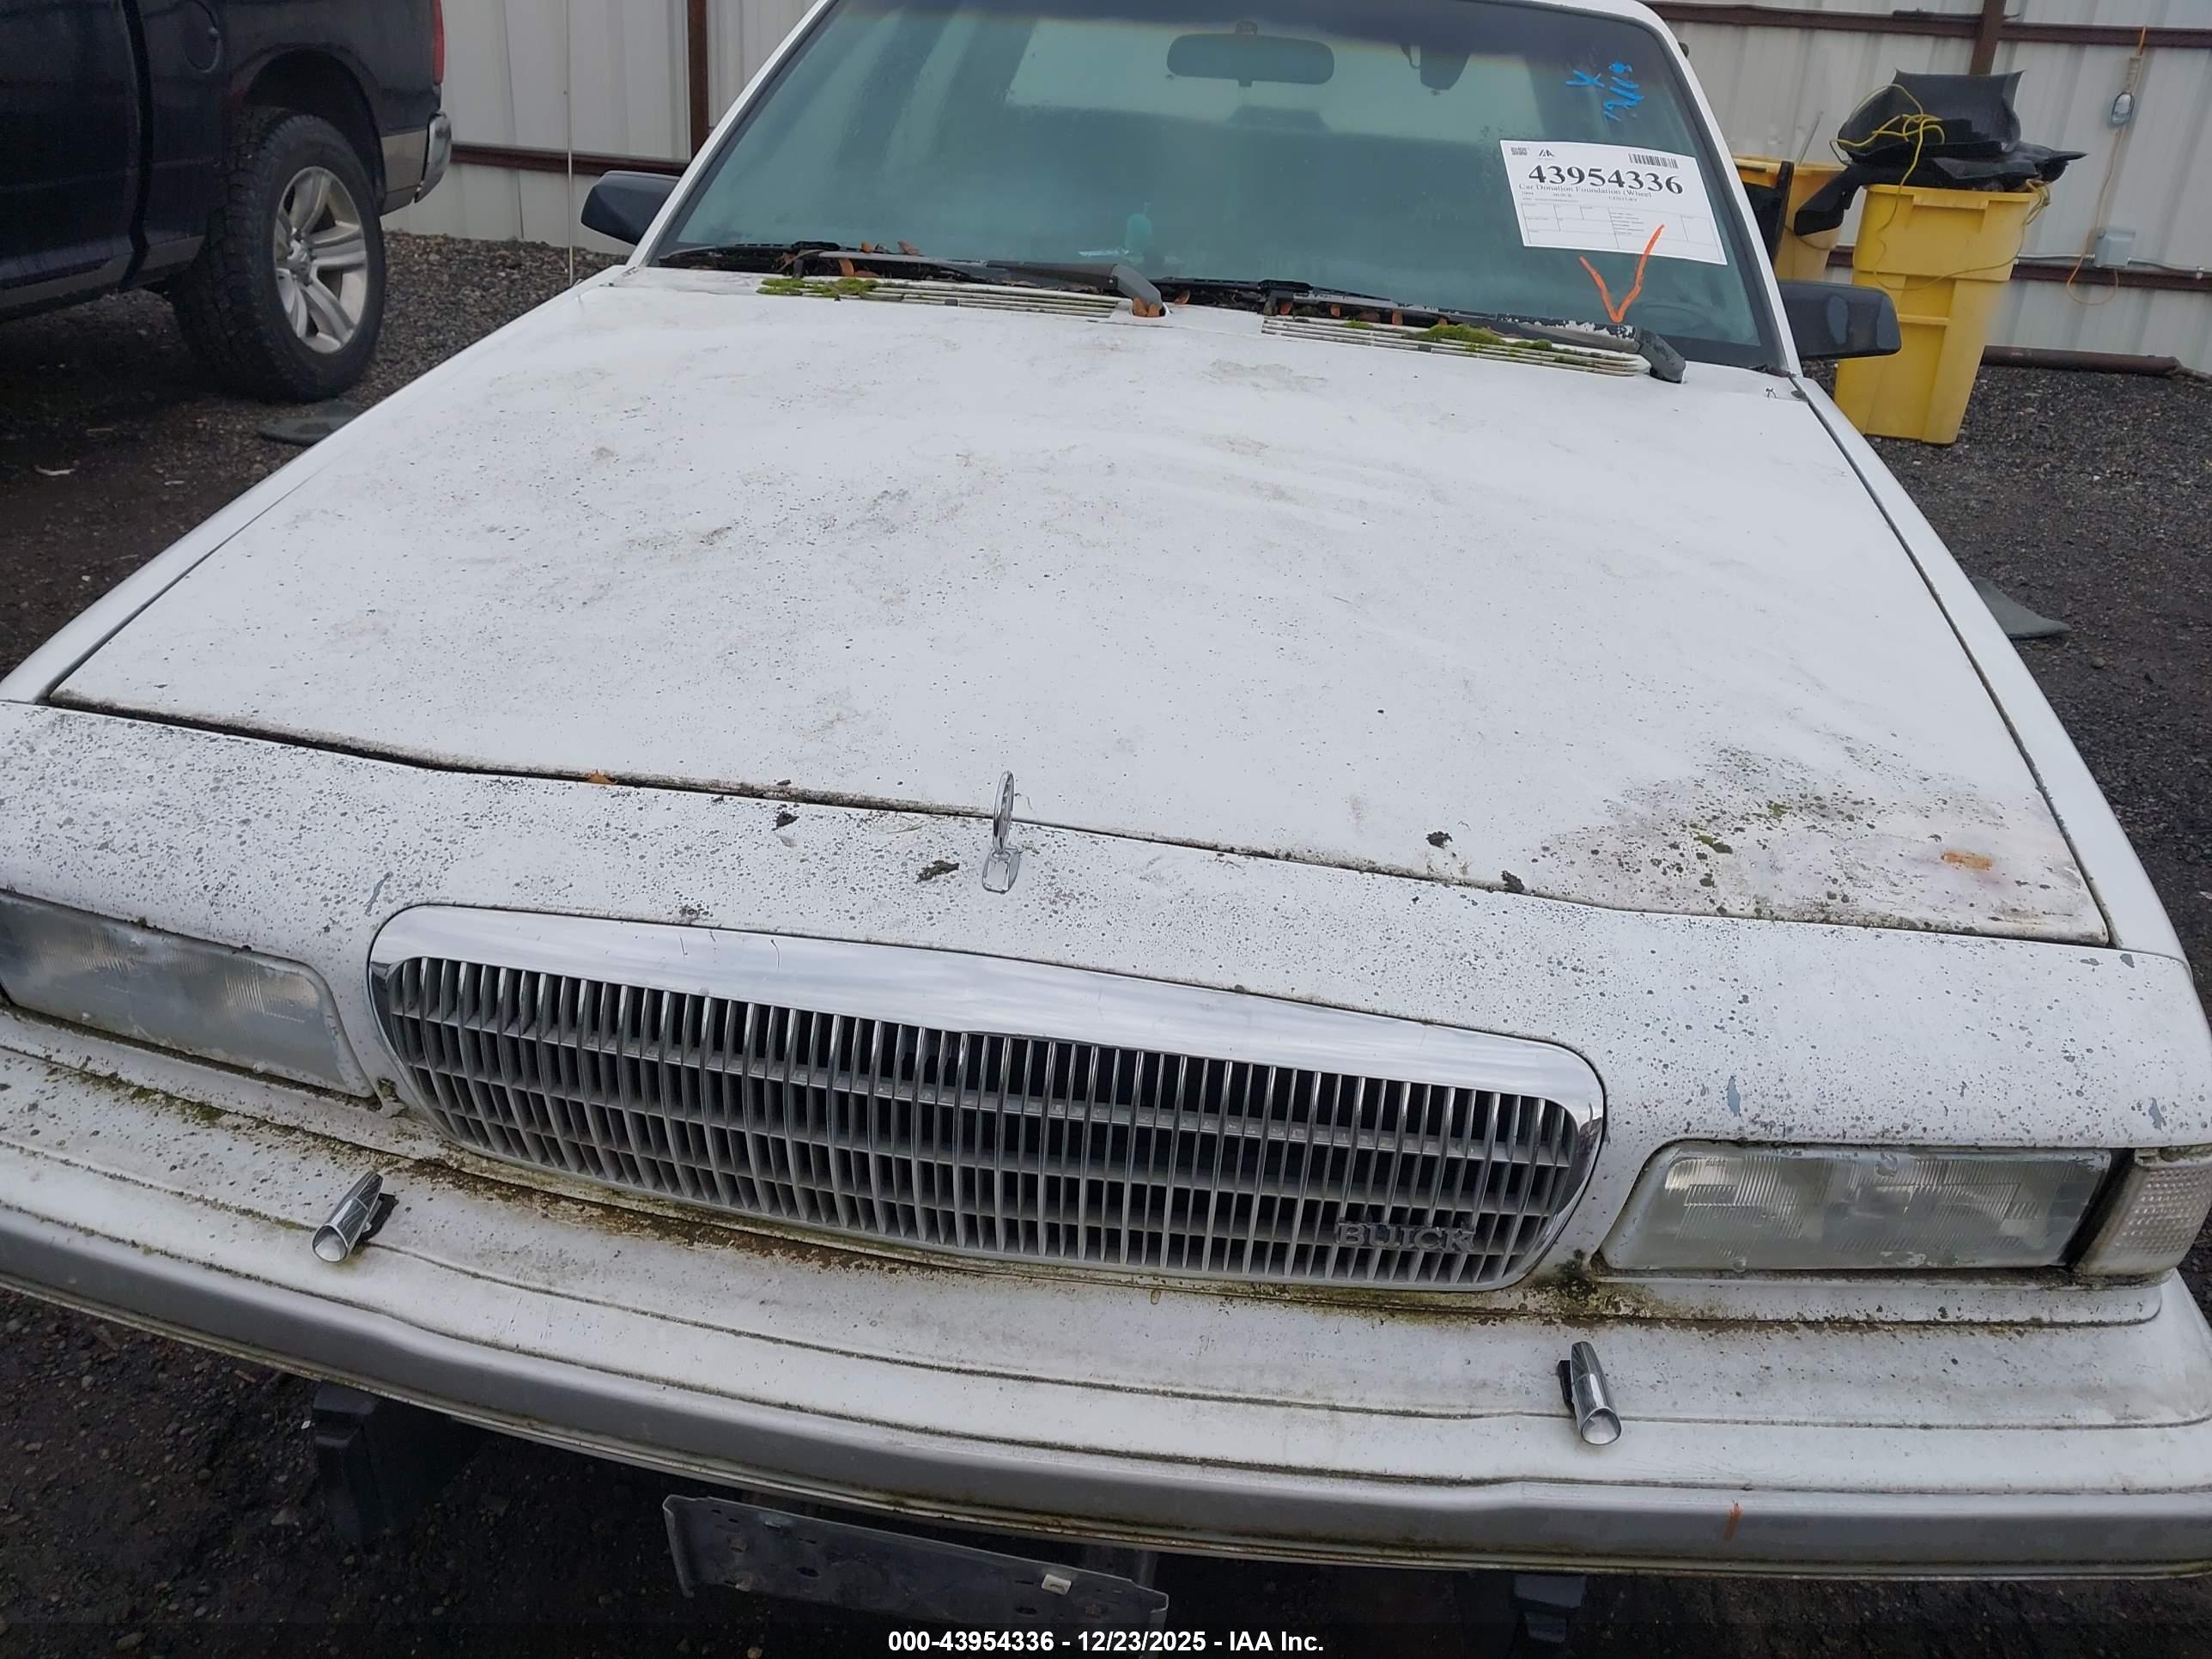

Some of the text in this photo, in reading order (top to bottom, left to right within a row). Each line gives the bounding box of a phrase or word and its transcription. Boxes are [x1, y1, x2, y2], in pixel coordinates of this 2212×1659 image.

[1528, 165, 1683, 195] 43954336
[1536, 184, 1573, 193] Donation
[1576, 185, 1620, 196] Foundation
[1334, 1222, 1476, 1254] BUICK
